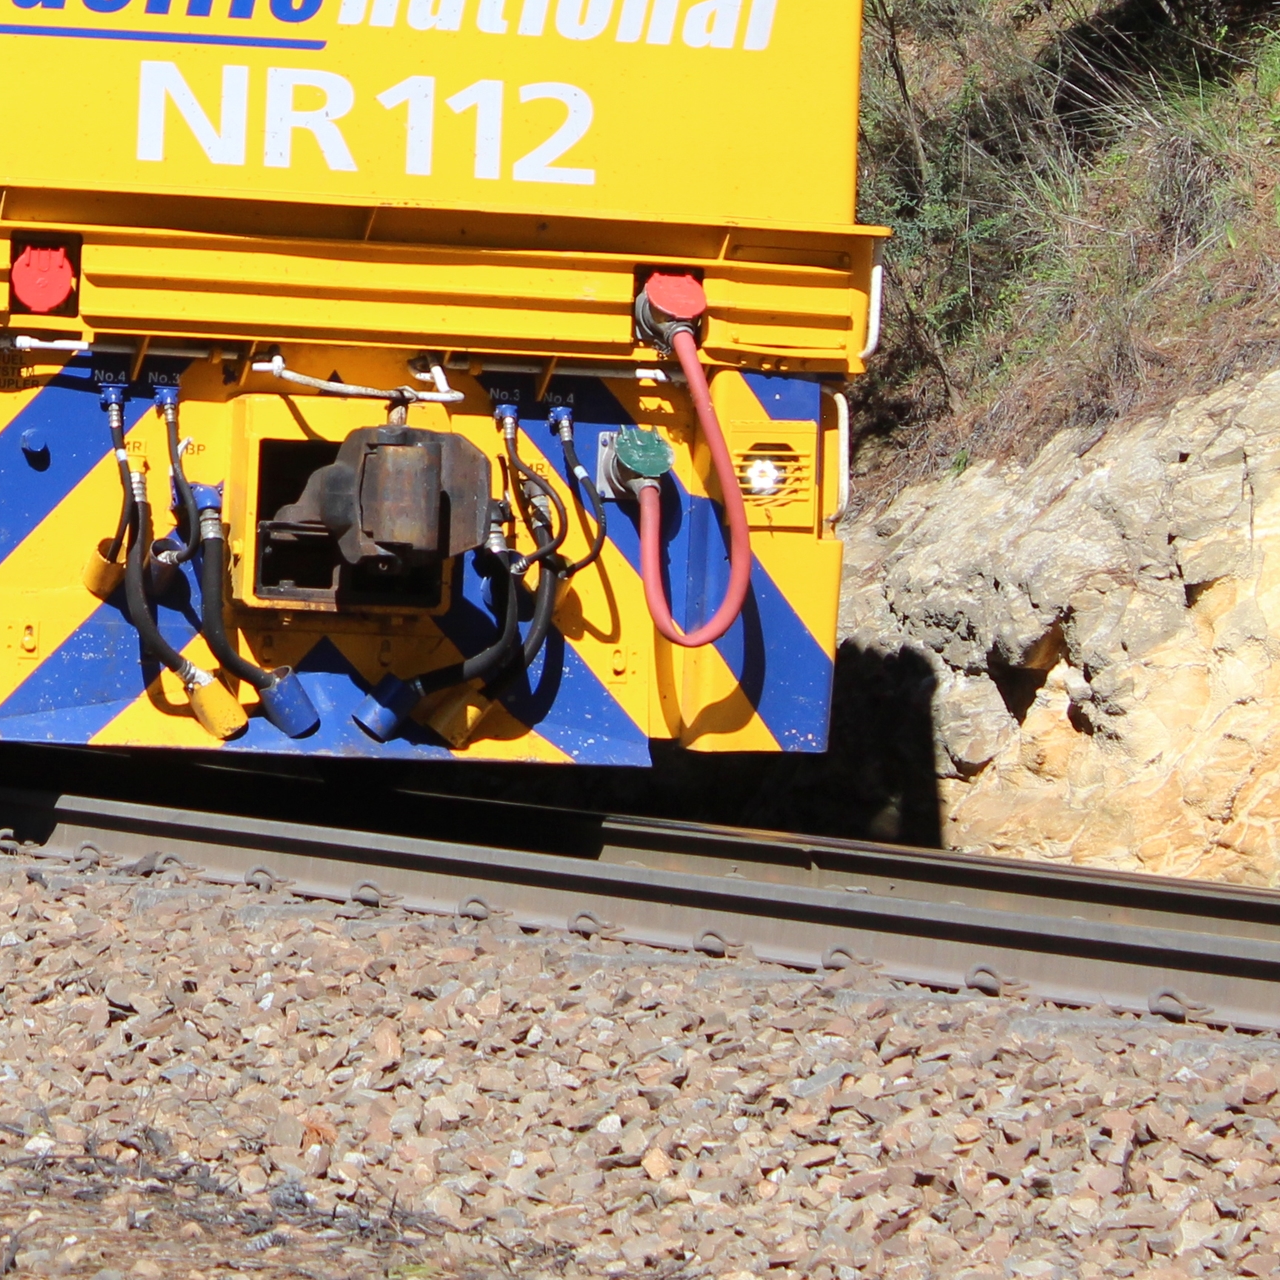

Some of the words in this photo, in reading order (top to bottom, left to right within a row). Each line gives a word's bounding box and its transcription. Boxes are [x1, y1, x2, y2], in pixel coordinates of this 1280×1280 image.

[94, 370, 126, 383] No.4
[148, 372, 180, 384] No.3
[489, 388, 520, 401] No.3
[542, 392, 574, 404] No.4
[184, 443, 206, 456] BP
